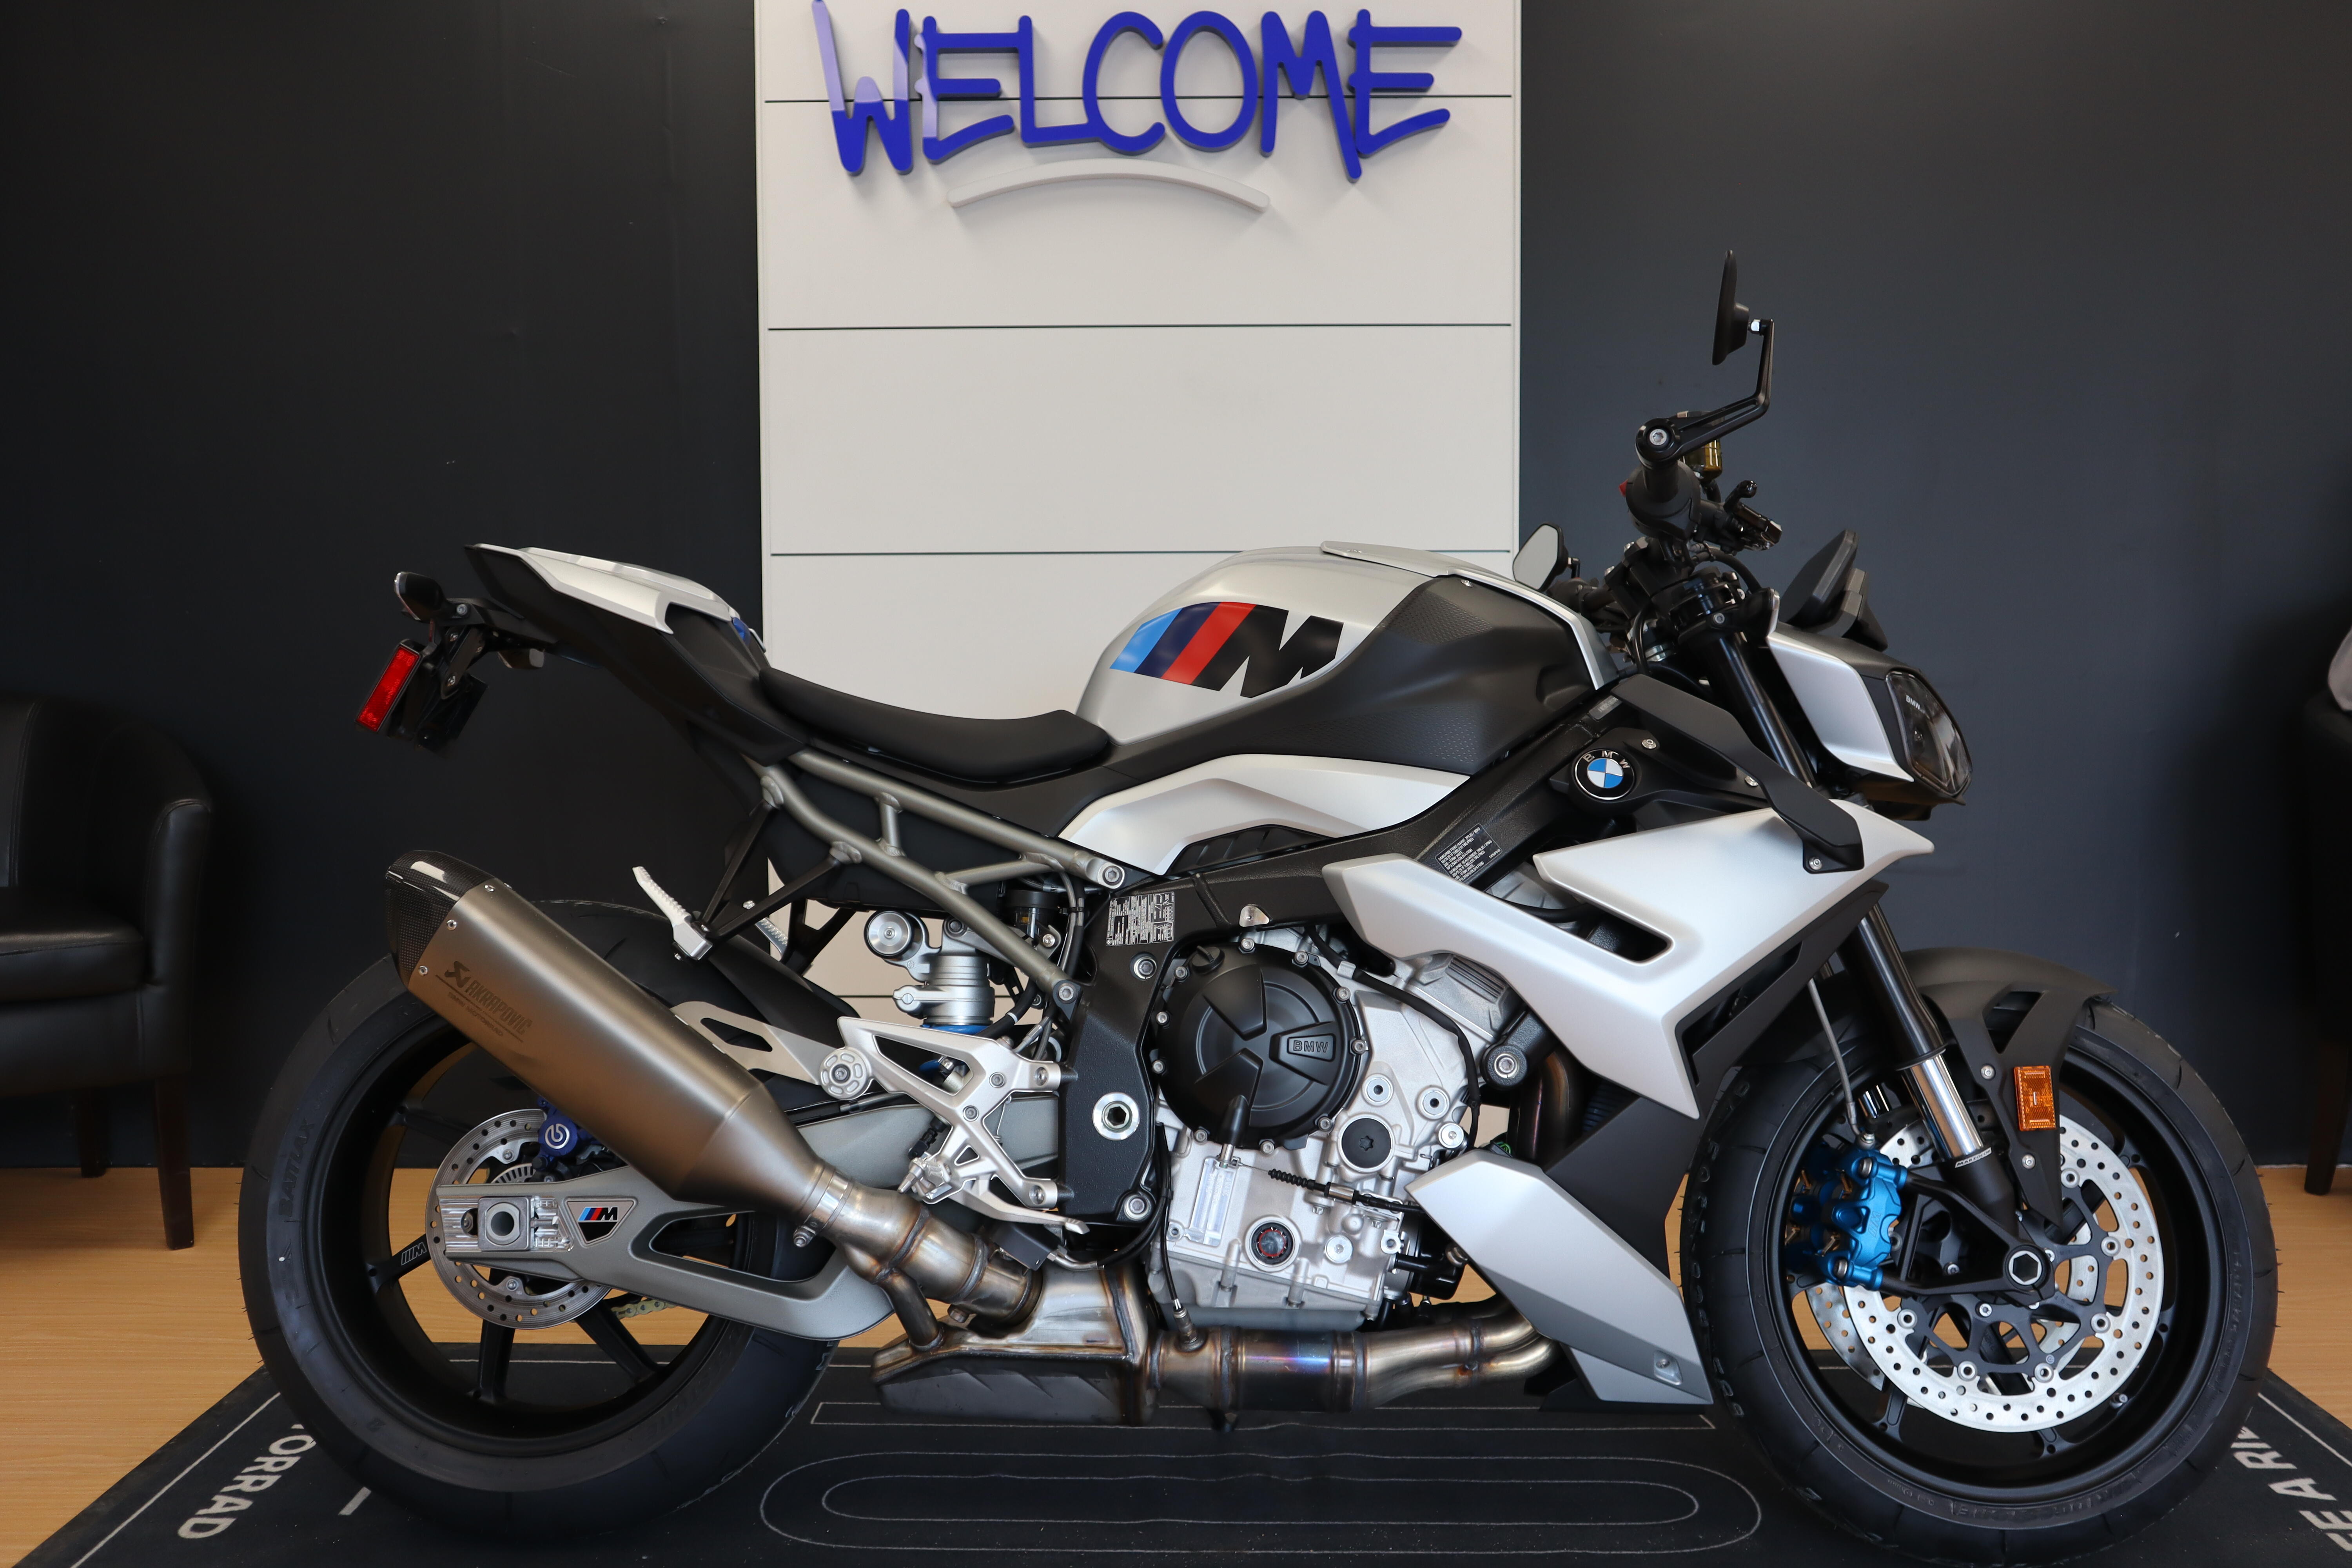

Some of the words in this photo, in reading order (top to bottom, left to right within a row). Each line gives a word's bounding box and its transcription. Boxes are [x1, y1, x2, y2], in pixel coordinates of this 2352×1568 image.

[812, 0, 1461, 182] WELCOME
[1190, 604, 1344, 699] M
[1906, 694, 1920, 710] BMW
[1583, 750, 1631, 769] BMW
[1293, 1040, 1329, 1053] BMW
[178, 1423, 317, 1539] ORRAD
[2268, 1477, 2337, 1501] A
